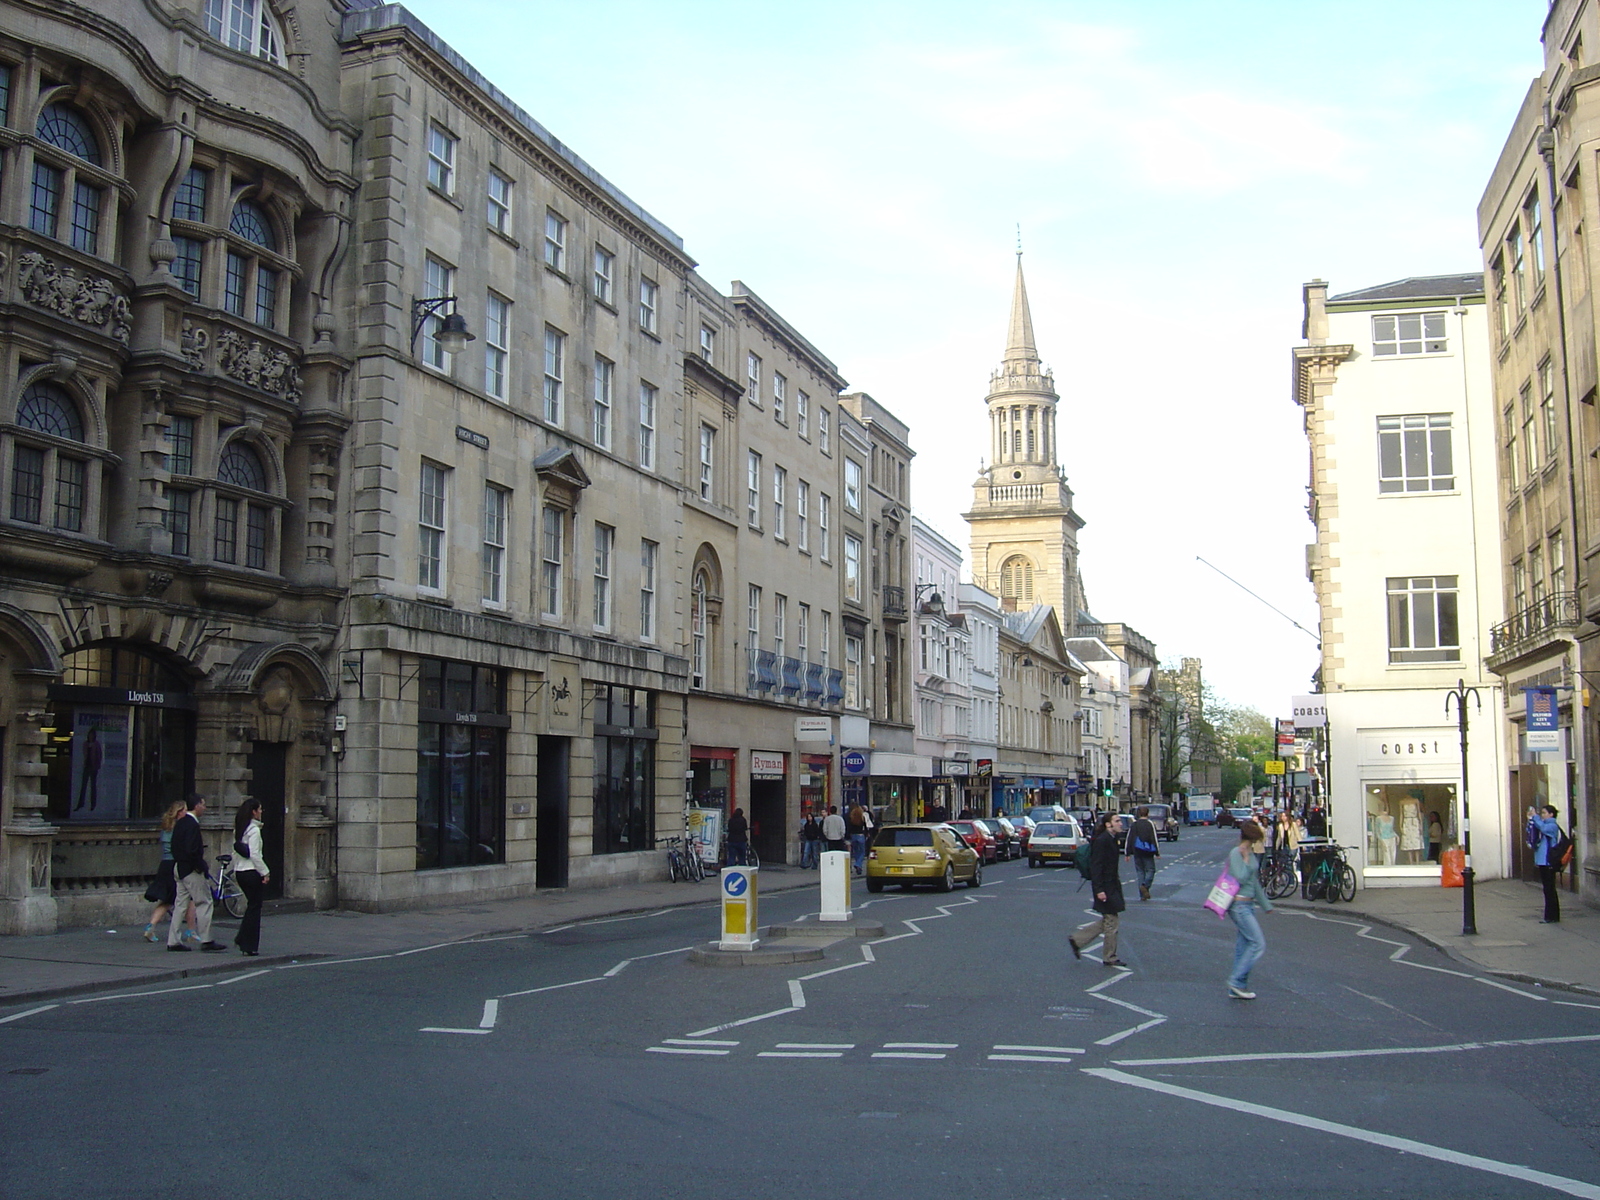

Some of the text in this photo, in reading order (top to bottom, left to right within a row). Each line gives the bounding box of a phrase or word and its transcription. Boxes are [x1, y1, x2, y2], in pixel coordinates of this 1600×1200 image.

[458, 428, 487, 445] HIGH STREET
[128, 690, 164, 704] Lloyds TSB
[1293, 706, 1325, 716] coast
[1381, 740, 1439, 755] coast
[754, 757, 782, 770] Ryman
